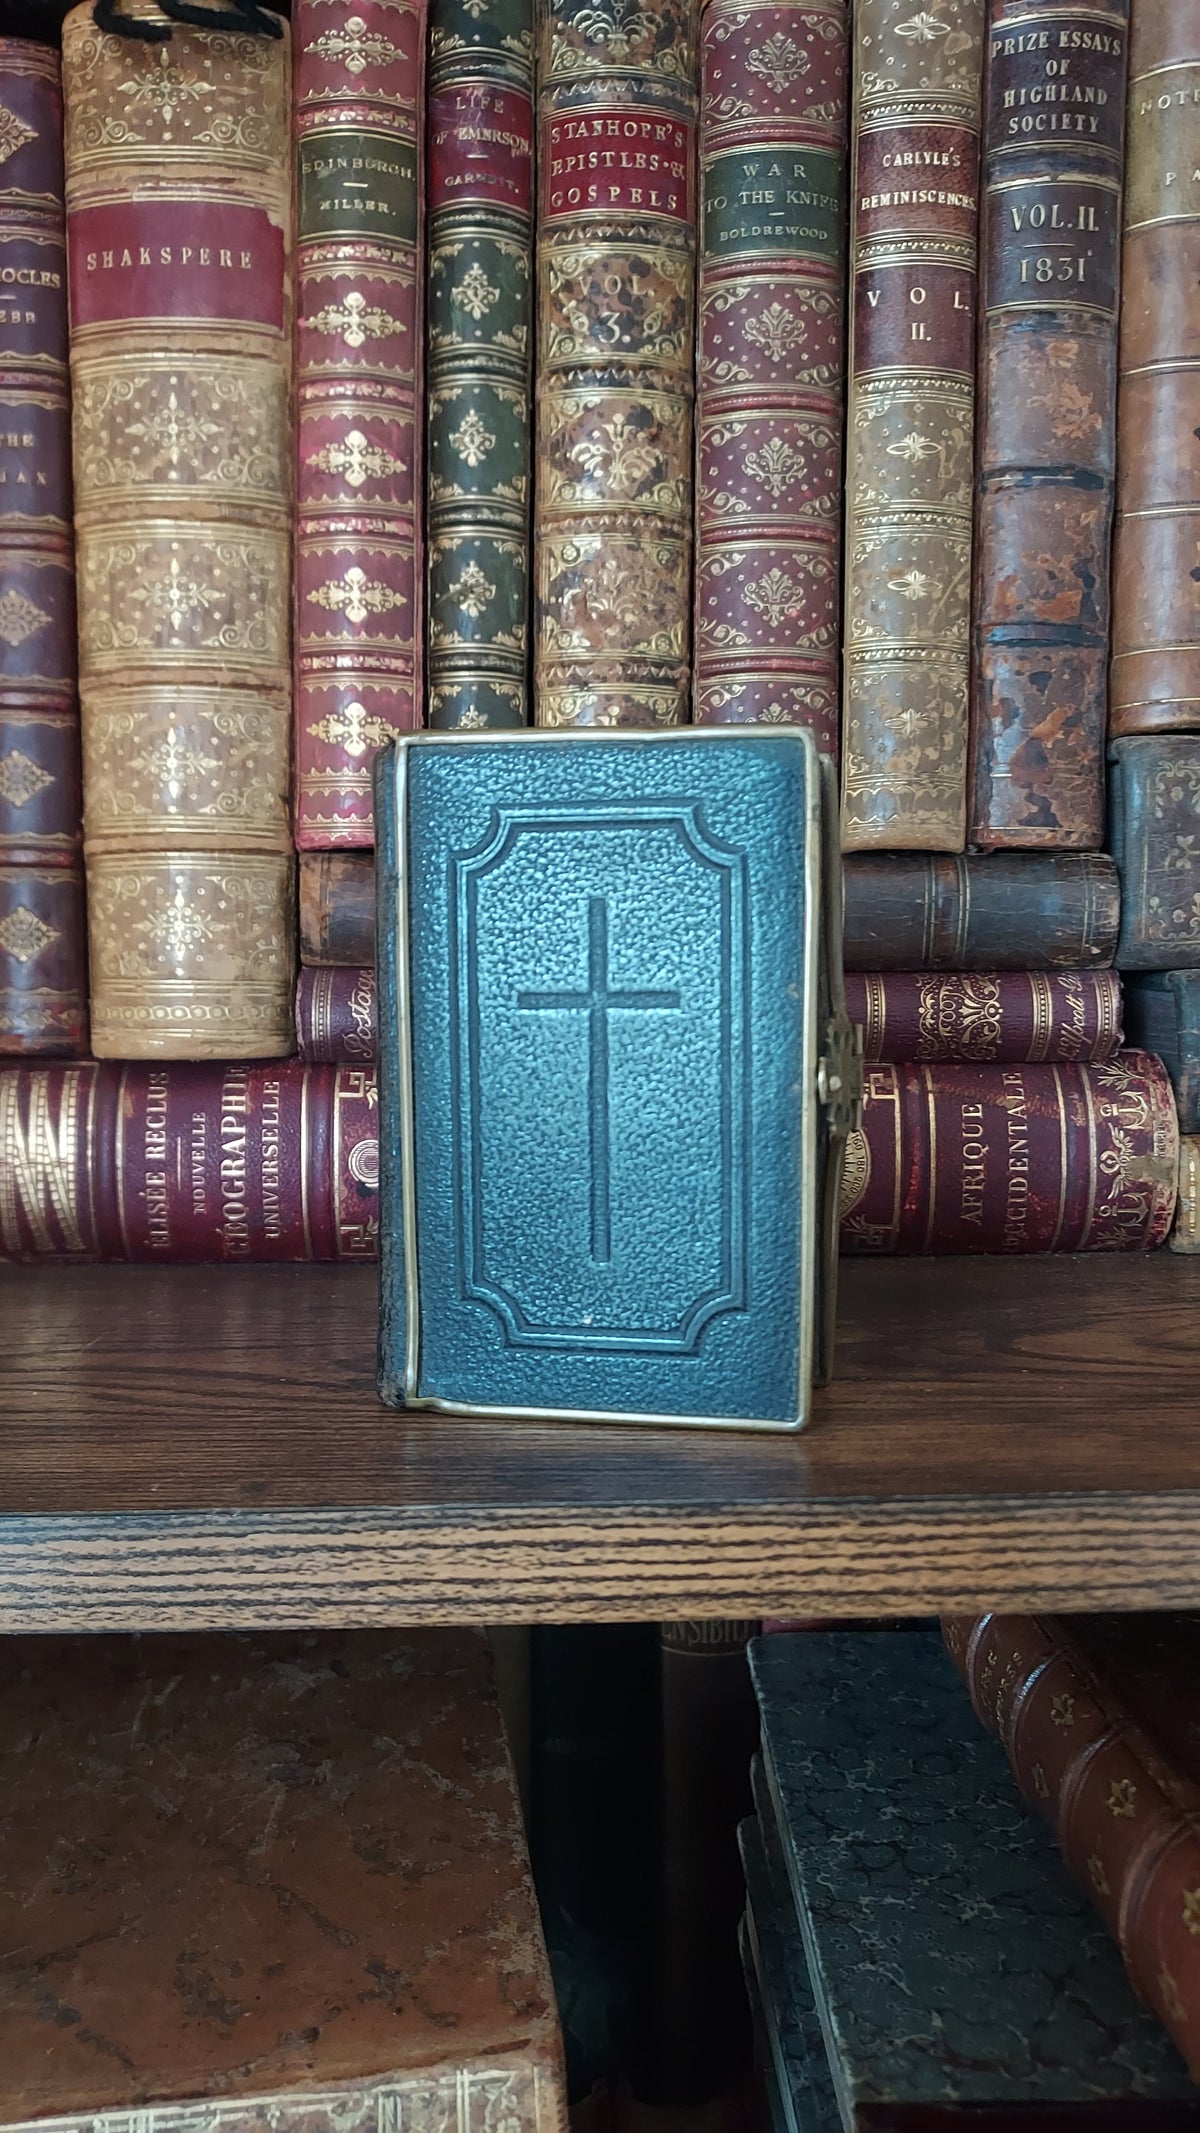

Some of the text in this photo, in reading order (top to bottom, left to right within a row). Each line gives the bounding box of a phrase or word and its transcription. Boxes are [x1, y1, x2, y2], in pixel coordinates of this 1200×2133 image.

[991, 31, 1121, 59] PRIZE ESSAYS
[1045, 59, 1071, 76] OF
[455, 96, 505, 115] LIFE
[1003, 82, 1109, 108] HIGHLAND
[1008, 113, 1101, 135] SOCIETY
[882, 147, 961, 168] CARLYLE'S
[742, 163, 807, 179] WAR
[551, 184, 678, 210] GOSPELS
[703, 190, 840, 214] TO THE KNIFE
[720, 225, 828, 242] BOLDREWOOD
[86, 247, 254, 272] SHAKSPERE
[1020, 257, 1086, 283] 1831
[0, 267, 61, 289] OCLES
[341, 969, 376, 1058] Postage
[145, 1072, 169, 1160] RECLUS
[191, 1111, 207, 1216] NOUVELLE
[215, 1065, 250, 1254] GÉOGRAPHIE
[261, 1080, 281, 1239] UNIVERSELLE
[856, 1156, 866, 1173] 180
[961, 1103, 989, 1226] AFRIQUE
